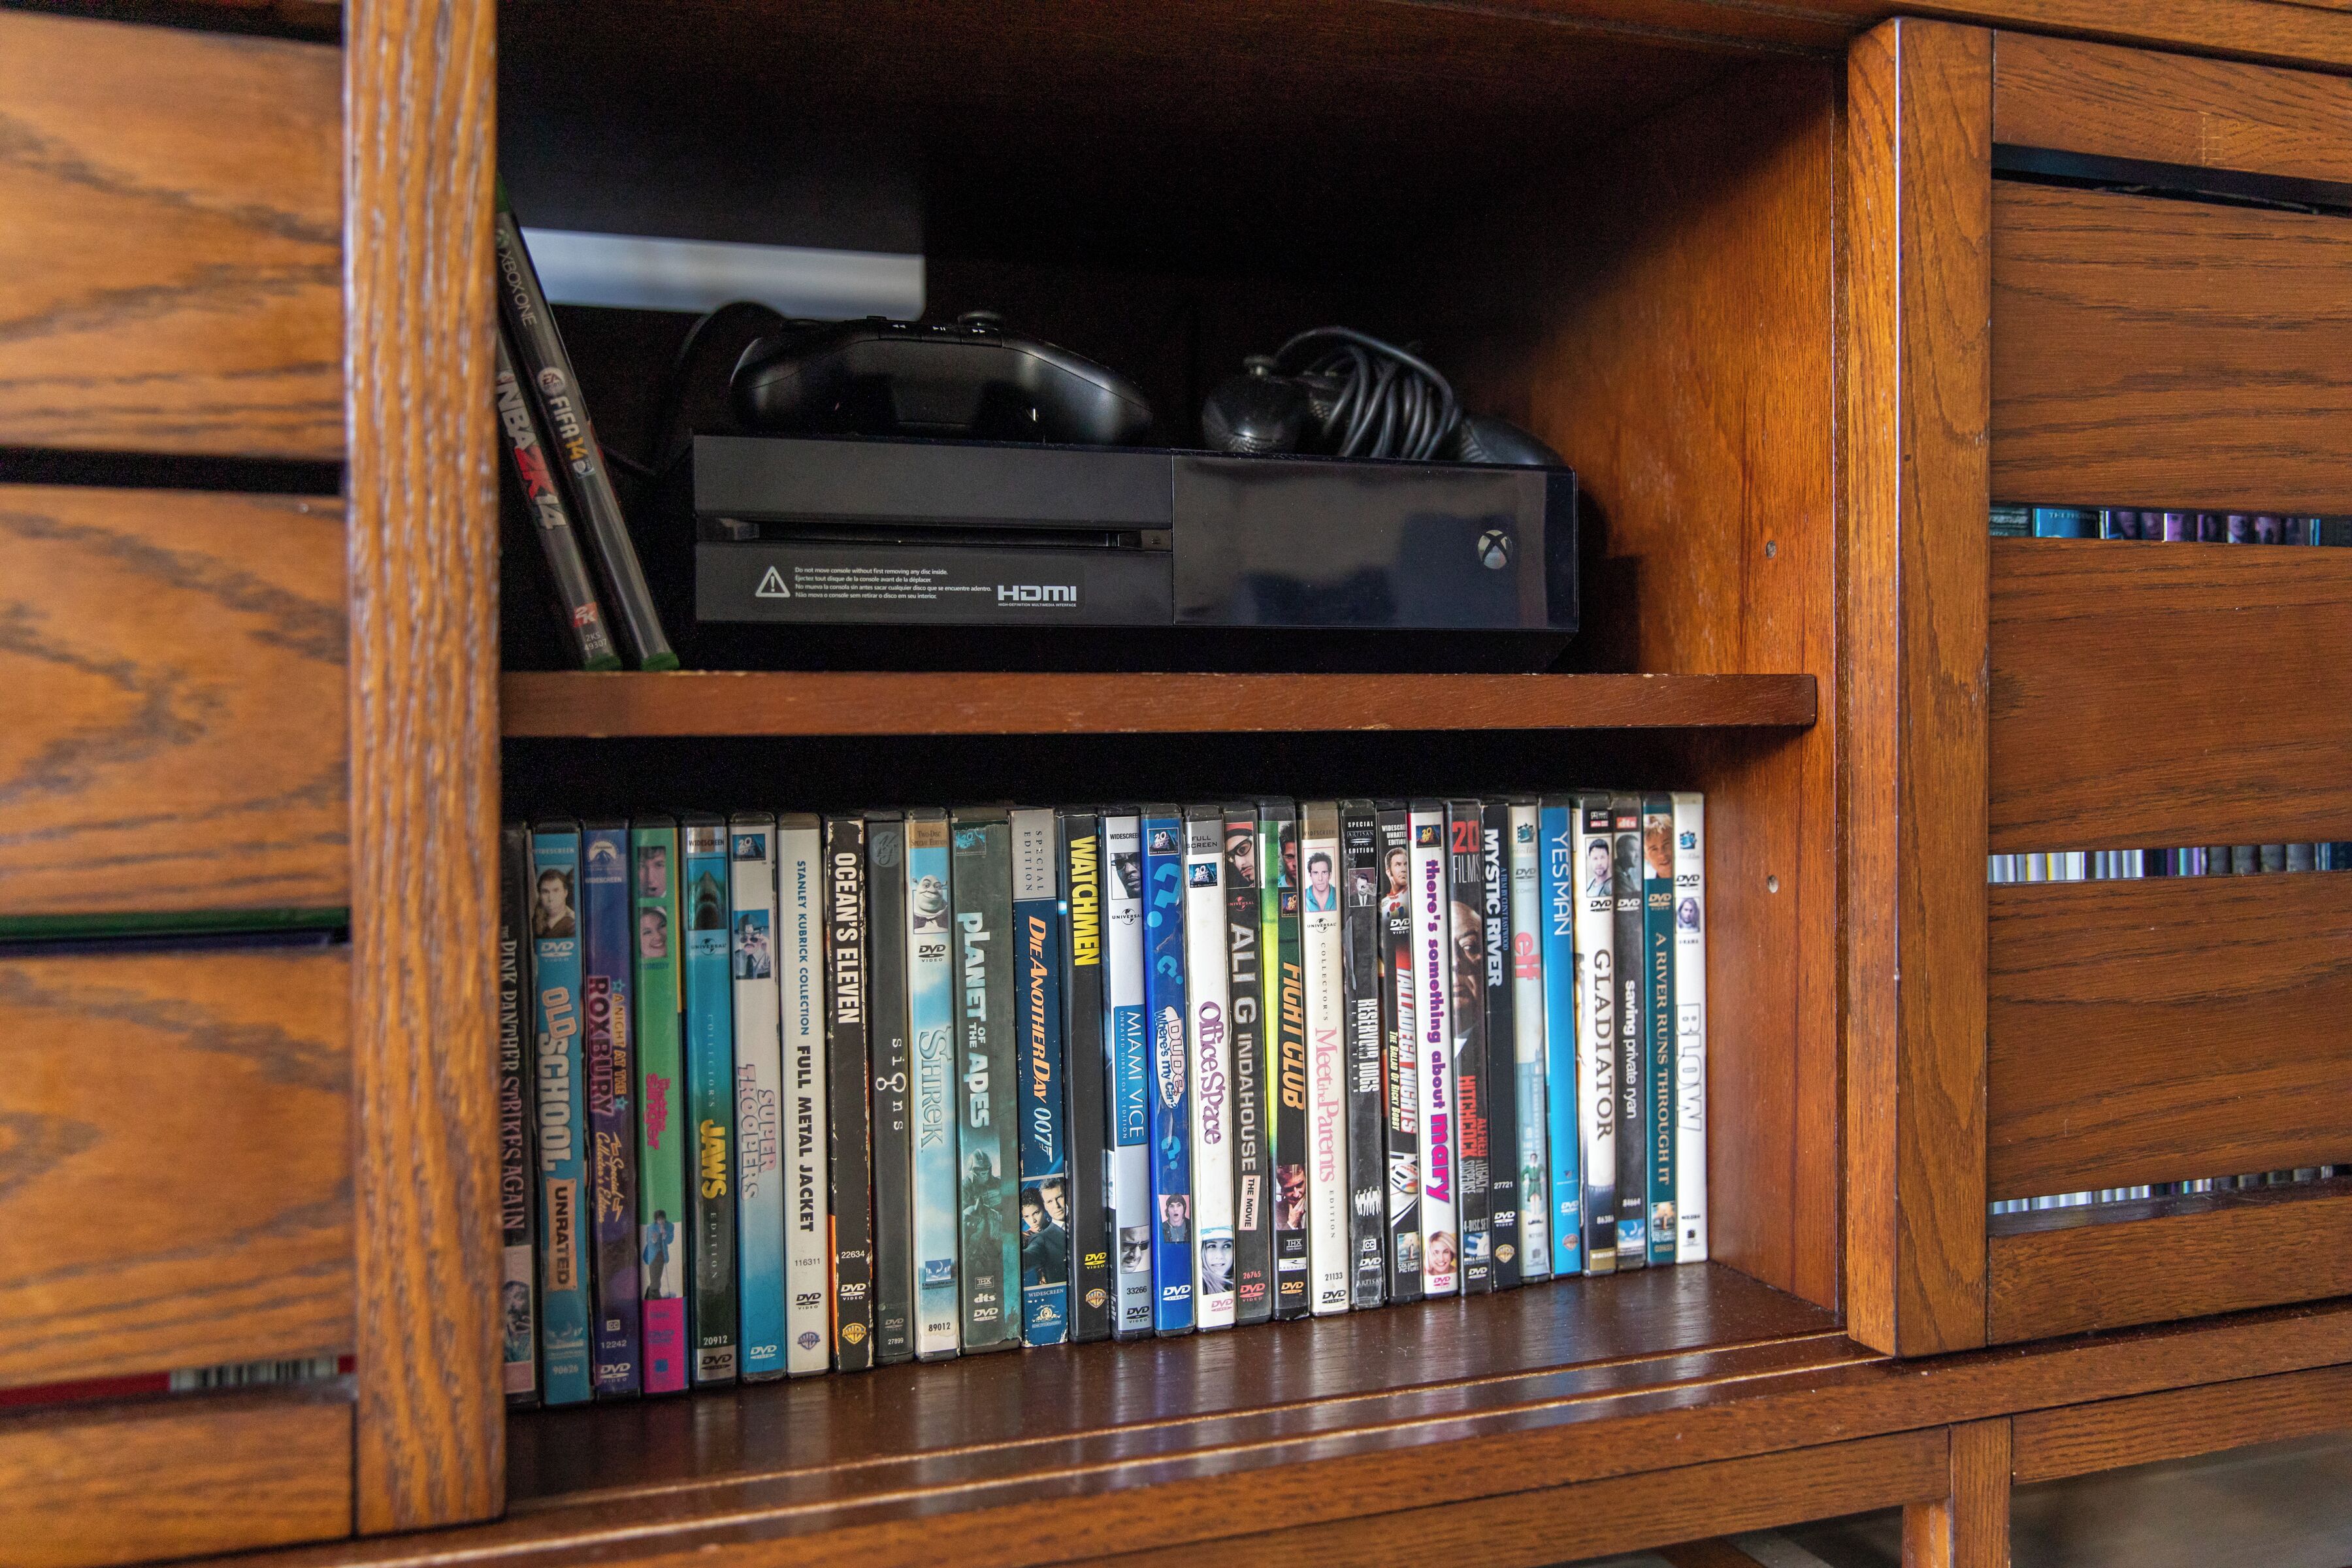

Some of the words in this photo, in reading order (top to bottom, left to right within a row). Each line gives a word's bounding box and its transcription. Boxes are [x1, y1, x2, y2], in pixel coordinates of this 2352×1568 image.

[498, 250, 525, 293] XBOX
[514, 292, 537, 327] ONE
[549, 396, 580, 439] FIFA
[565, 436, 588, 460] 14
[575, 606, 596, 623] 2K
[998, 585, 1077, 601] HDMI
[1024, 832, 1032, 891] EDITION
[1036, 830, 1044, 891] SPECIAL
[1452, 820, 1479, 853] 20
[1552, 833, 1569, 878] YES
[797, 860, 806, 909] STANLEY
[1452, 853, 1481, 883] FILMS
[1484, 828, 1500, 915] MYSTIC
[834, 852, 858, 941] OCEAN'S
[1071, 836, 1100, 966] WATCHMEN
[1426, 860, 1441, 933] there's
[1553, 883, 1571, 936] MAN
[798, 913, 808, 963] KUBRICK
[1028, 916, 1047, 958] DIE
[1231, 923, 1256, 983] ALI
[1487, 918, 1503, 987] RIVER
[1514, 932, 1541, 981] elf
[1656, 933, 1667, 946] A
[501, 941, 517, 985] PINK
[836, 947, 860, 1023] ELEVEN
[957, 912, 990, 1022] PLANET
[1656, 951, 1667, 1009] RIVER
[542, 987, 577, 1039] OLD
[613, 994, 624, 1003] A
[799, 968, 809, 1036] COLLECTION
[1030, 955, 1048, 1059] ANOTHER
[1233, 996, 1256, 1024] G
[1282, 962, 1303, 1038] FIGHT
[1426, 939, 1444, 1043] something
[1623, 979, 1638, 1036] saving
[501, 990, 520, 1071] PANTHER
[613, 1005, 625, 1048] NIGHT
[968, 1022, 977, 1048] THE
[977, 1026, 986, 1044] OF
[1358, 998, 1379, 1059] RESERVOIR
[1389, 1031, 1397, 1044] THE
[1397, 966, 1415, 1068] TALLADEGA
[1656, 1014, 1668, 1065] RUNS
[587, 975, 614, 1117] ROXBURY
[613, 1050, 626, 1068] AT
[796, 1045, 811, 1088] FULL
[1127, 1012, 1143, 1080] MIAMI
[1161, 1060, 1172, 1080] my
[1315, 1027, 1337, 1085] Meet
[1390, 1045, 1399, 1070] BALLAD
[1594, 949, 1613, 1141] GLADIATOR
[1623, 1039, 1639, 1083] private
[1676, 1003, 1702, 1132] BLOW
[614, 1069, 627, 1095] THE
[963, 1052, 989, 1128] APES
[1032, 1061, 1051, 1103] DAY
[1282, 1041, 1305, 1110] CLUB
[1316, 1082, 1330, 1110] the
[1359, 1062, 1379, 1092] DOGS
[1390, 1072, 1399, 1083] OF
[1391, 1083, 1400, 1106] RICKY
[1398, 1068, 1417, 1134] NIGHTS
[1431, 1050, 1446, 1109] about
[501, 1076, 523, 1163] STRIKES
[539, 1032, 571, 1171] SCHOOL
[797, 1096, 813, 1158] METAL
[1129, 1088, 1144, 1137] VICE
[1237, 1033, 1256, 1171] INDAHOUSE
[1392, 1107, 1400, 1130] BOBBY
[1458, 1075, 1478, 1159] HITCHCOCK
[1624, 1088, 1637, 1119] ryan
[1657, 1068, 1669, 1162] THROUGH
[738, 1064, 759, 1201] TROOPERS
[758, 1089, 777, 1173] SUPER
[1034, 1107, 1053, 1163] 007
[1318, 1098, 1339, 1183] Parents
[700, 1119, 727, 1199] JAWS
[1426, 1113, 1450, 1203] mary
[1658, 1168, 1669, 1185] IT
[502, 1165, 525, 1228] AGAIN
[799, 1164, 814, 1232] JACKET
[1245, 1198, 1253, 1228] MOVIE
[555, 1186, 570, 1285] UNRATED
[841, 1250, 865, 1259] 22634
[1085, 1252, 1107, 1262] DVD
[794, 1258, 821, 1266] 116311
[1243, 1271, 1261, 1280] 26765
[974, 1294, 996, 1303] dts
[1028, 1288, 1064, 1298] WIDESCREEN
[1126, 1286, 1147, 1295] 33266
[1127, 1306, 1149, 1316] DVD
[1163, 1285, 1191, 1296] DVD
[1322, 1290, 1347, 1299] DVD
[600, 1339, 627, 1349] 12242
[703, 1335, 728, 1346] 20912
[928, 1322, 951, 1331] 89012
